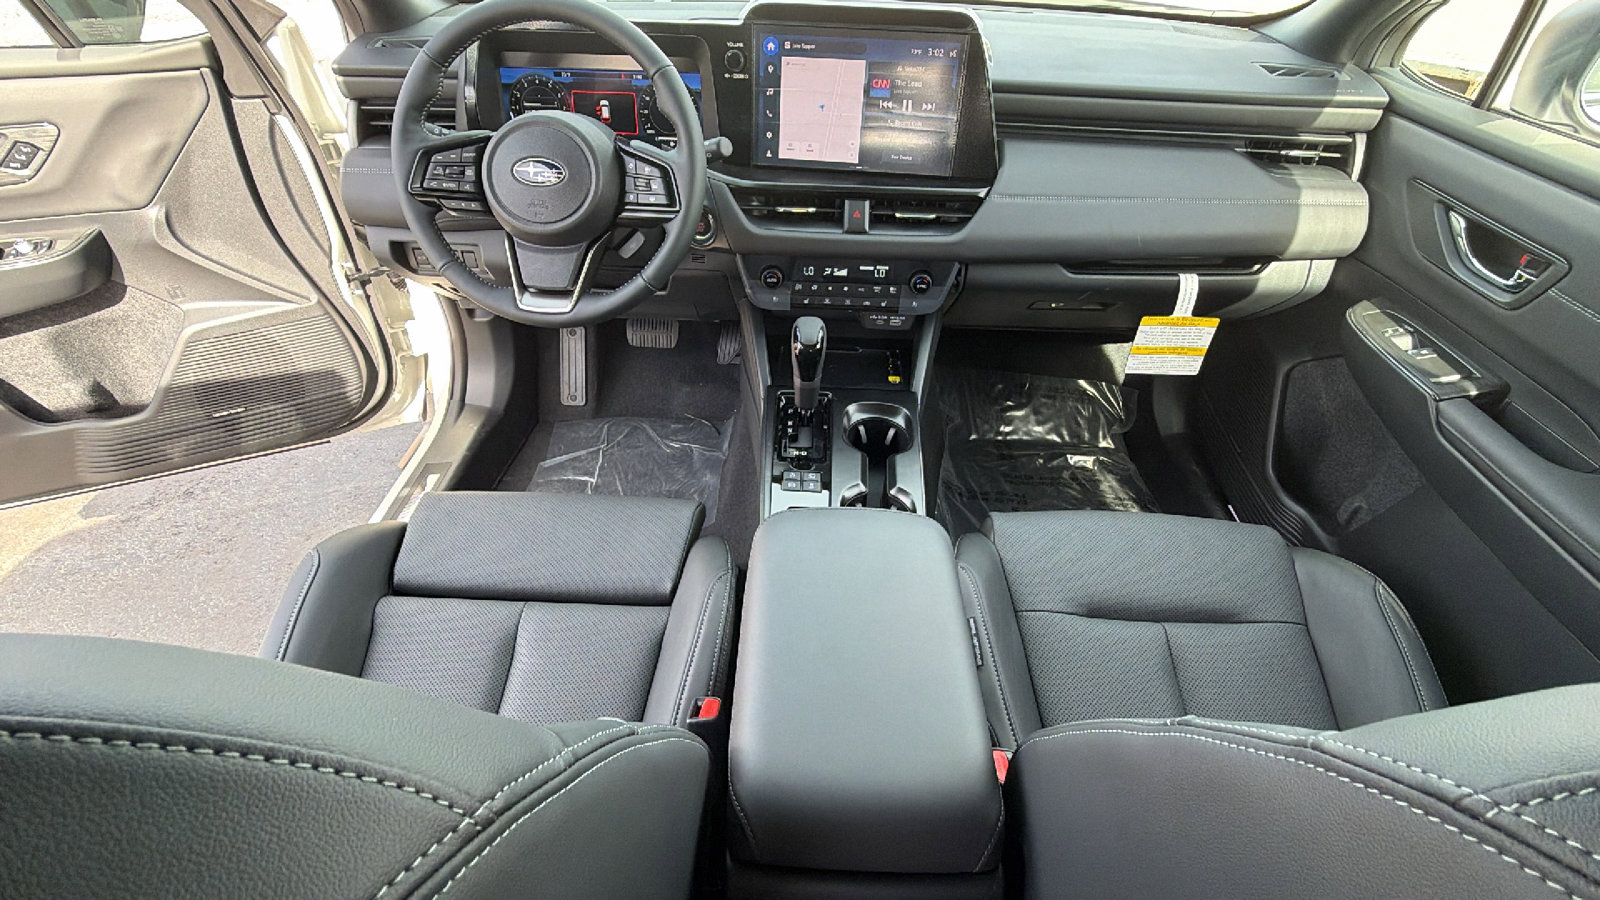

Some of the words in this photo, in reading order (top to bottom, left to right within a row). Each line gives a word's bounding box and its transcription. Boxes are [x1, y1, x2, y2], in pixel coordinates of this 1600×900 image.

[927, 47, 944, 57] 3:02
[872, 79, 890, 89] CNN
[894, 79, 907, 87] The
[907, 80, 922, 88] Lead
[803, 266, 814, 276] LO
[874, 269, 886, 278] LO
